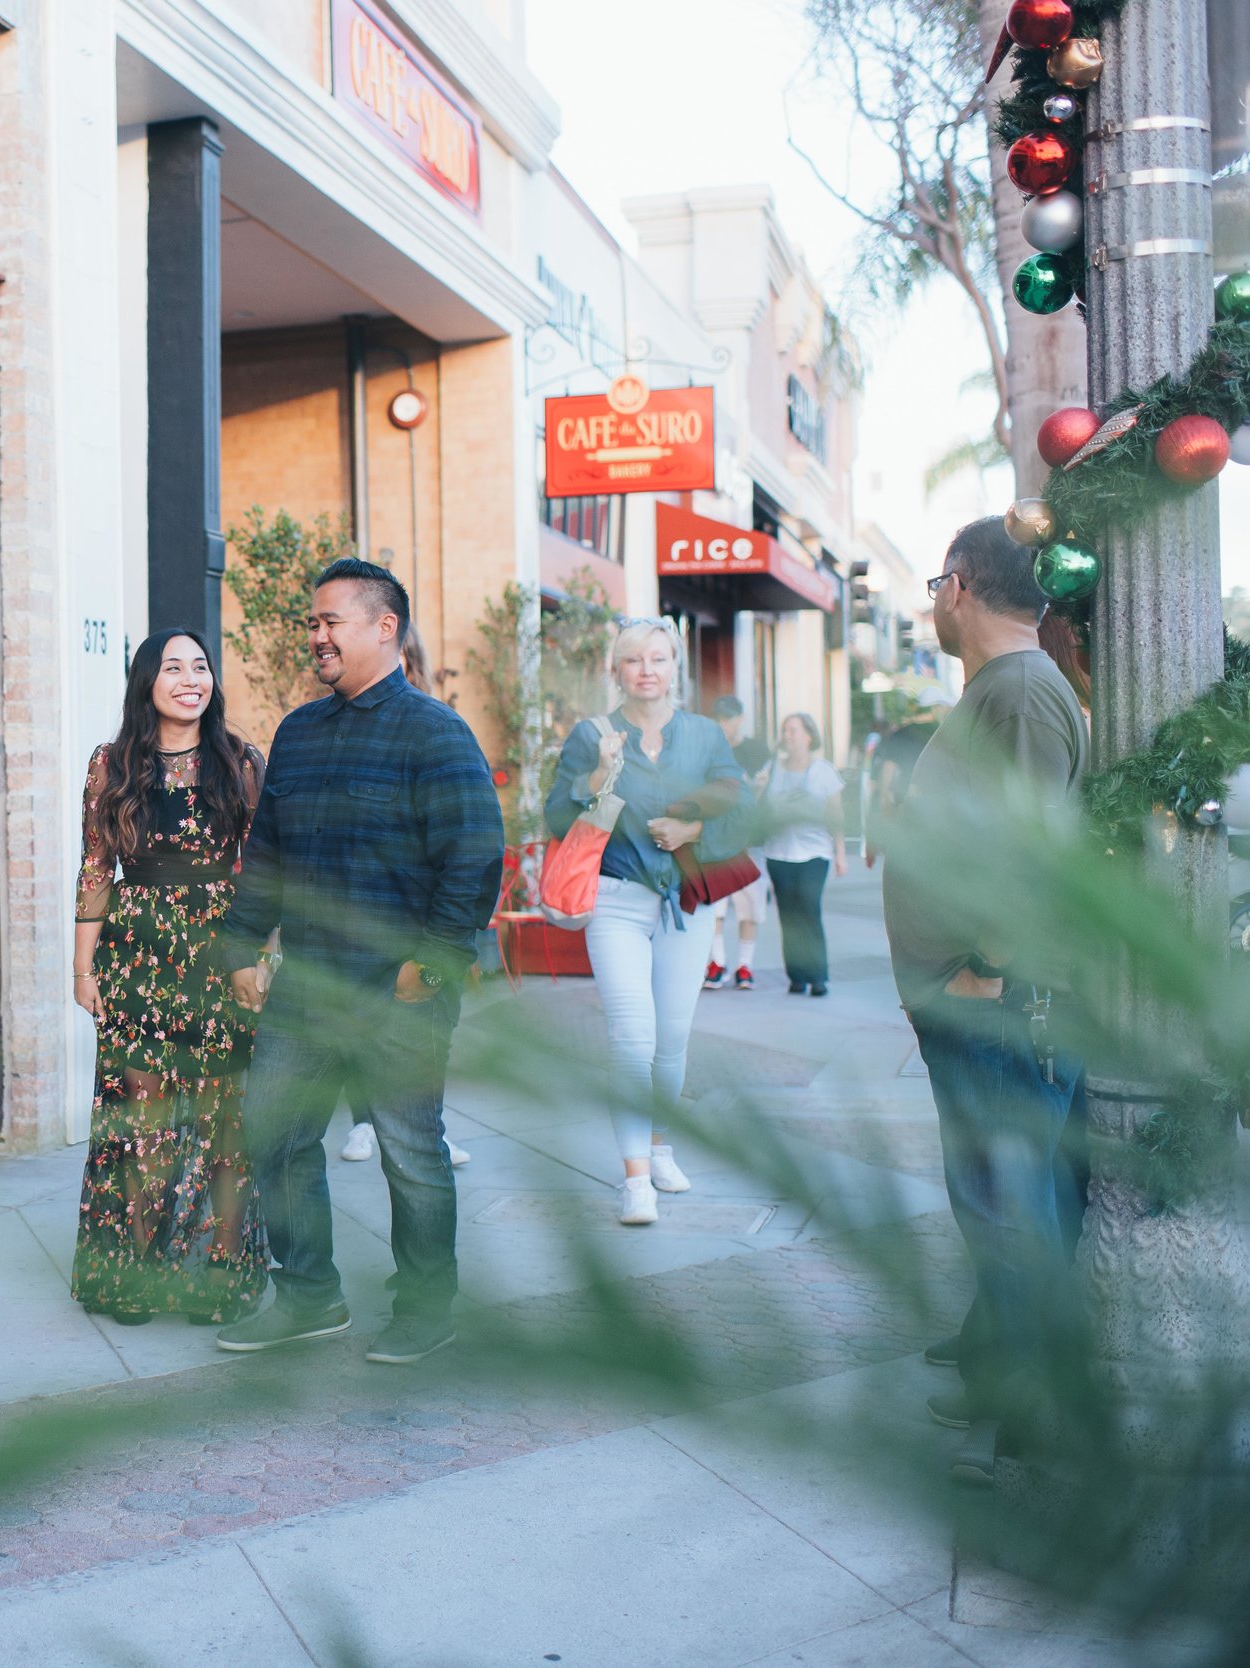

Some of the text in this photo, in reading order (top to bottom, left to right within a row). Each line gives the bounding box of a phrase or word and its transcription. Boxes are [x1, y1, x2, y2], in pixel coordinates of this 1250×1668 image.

[557, 411, 619, 451] CAFÉ
[636, 409, 703, 446] SURO
[608, 463, 652, 480] BAKERY
[670, 537, 753, 561] rico
[84, 618, 107, 654] 375
